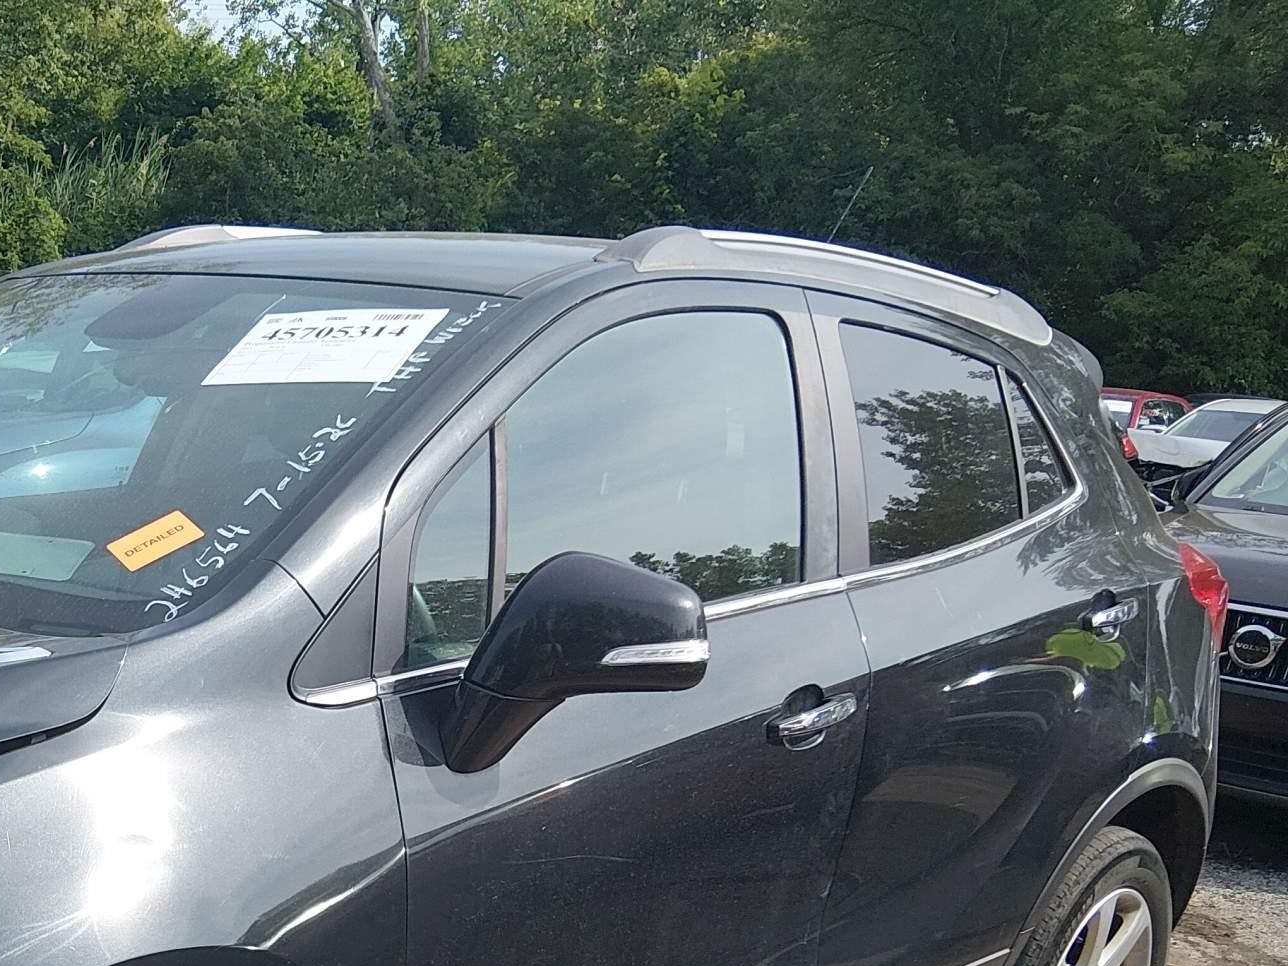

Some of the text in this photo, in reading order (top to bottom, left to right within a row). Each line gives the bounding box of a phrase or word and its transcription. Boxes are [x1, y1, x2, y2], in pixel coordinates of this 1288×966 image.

[262, 325, 409, 340] 45705314
[123, 523, 185, 558] DETAILED
[1235, 641, 1269, 653] VOLVO
